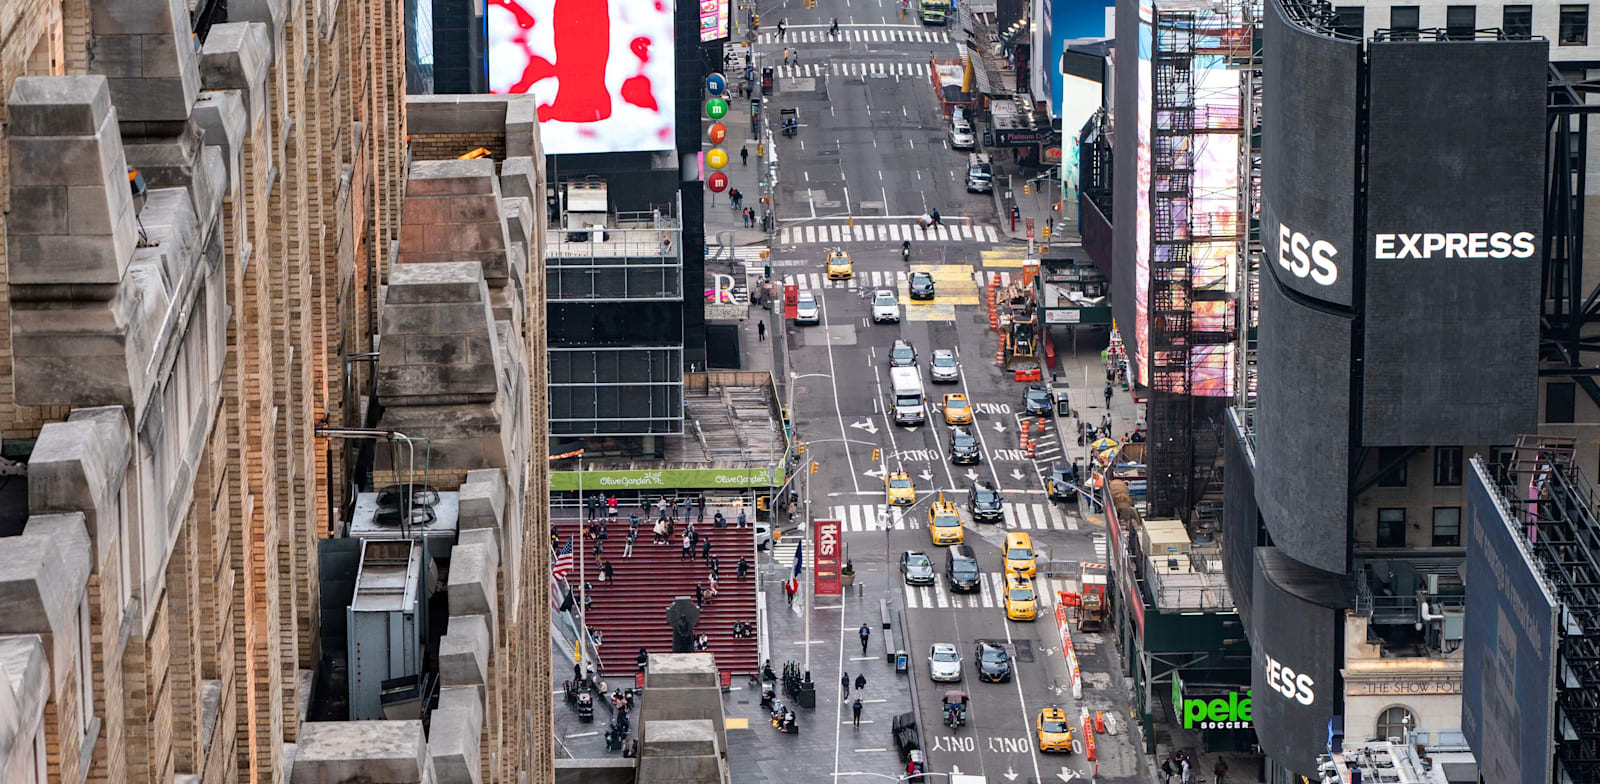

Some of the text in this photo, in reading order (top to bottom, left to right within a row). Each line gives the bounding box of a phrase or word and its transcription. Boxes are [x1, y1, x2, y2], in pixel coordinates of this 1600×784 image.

[709, 81, 718, 90] m
[712, 105, 722, 114] m
[717, 130, 724, 138] m
[1007, 132, 1034, 140] Platinum
[712, 156, 721, 164] m
[715, 179, 724, 187] m
[1375, 231, 1535, 259] EXPRESS
[712, 272, 750, 306] R
[975, 403, 1010, 415] ONLY
[903, 449, 939, 461] ONLY
[820, 523, 838, 556] tkts
[1368, 682, 1389, 692] THE
[1393, 681, 1429, 692] SHOW
[1200, 721, 1249, 729] SOCCER
[932, 736, 975, 752] ONLY
[988, 737, 1030, 753] ONLY
